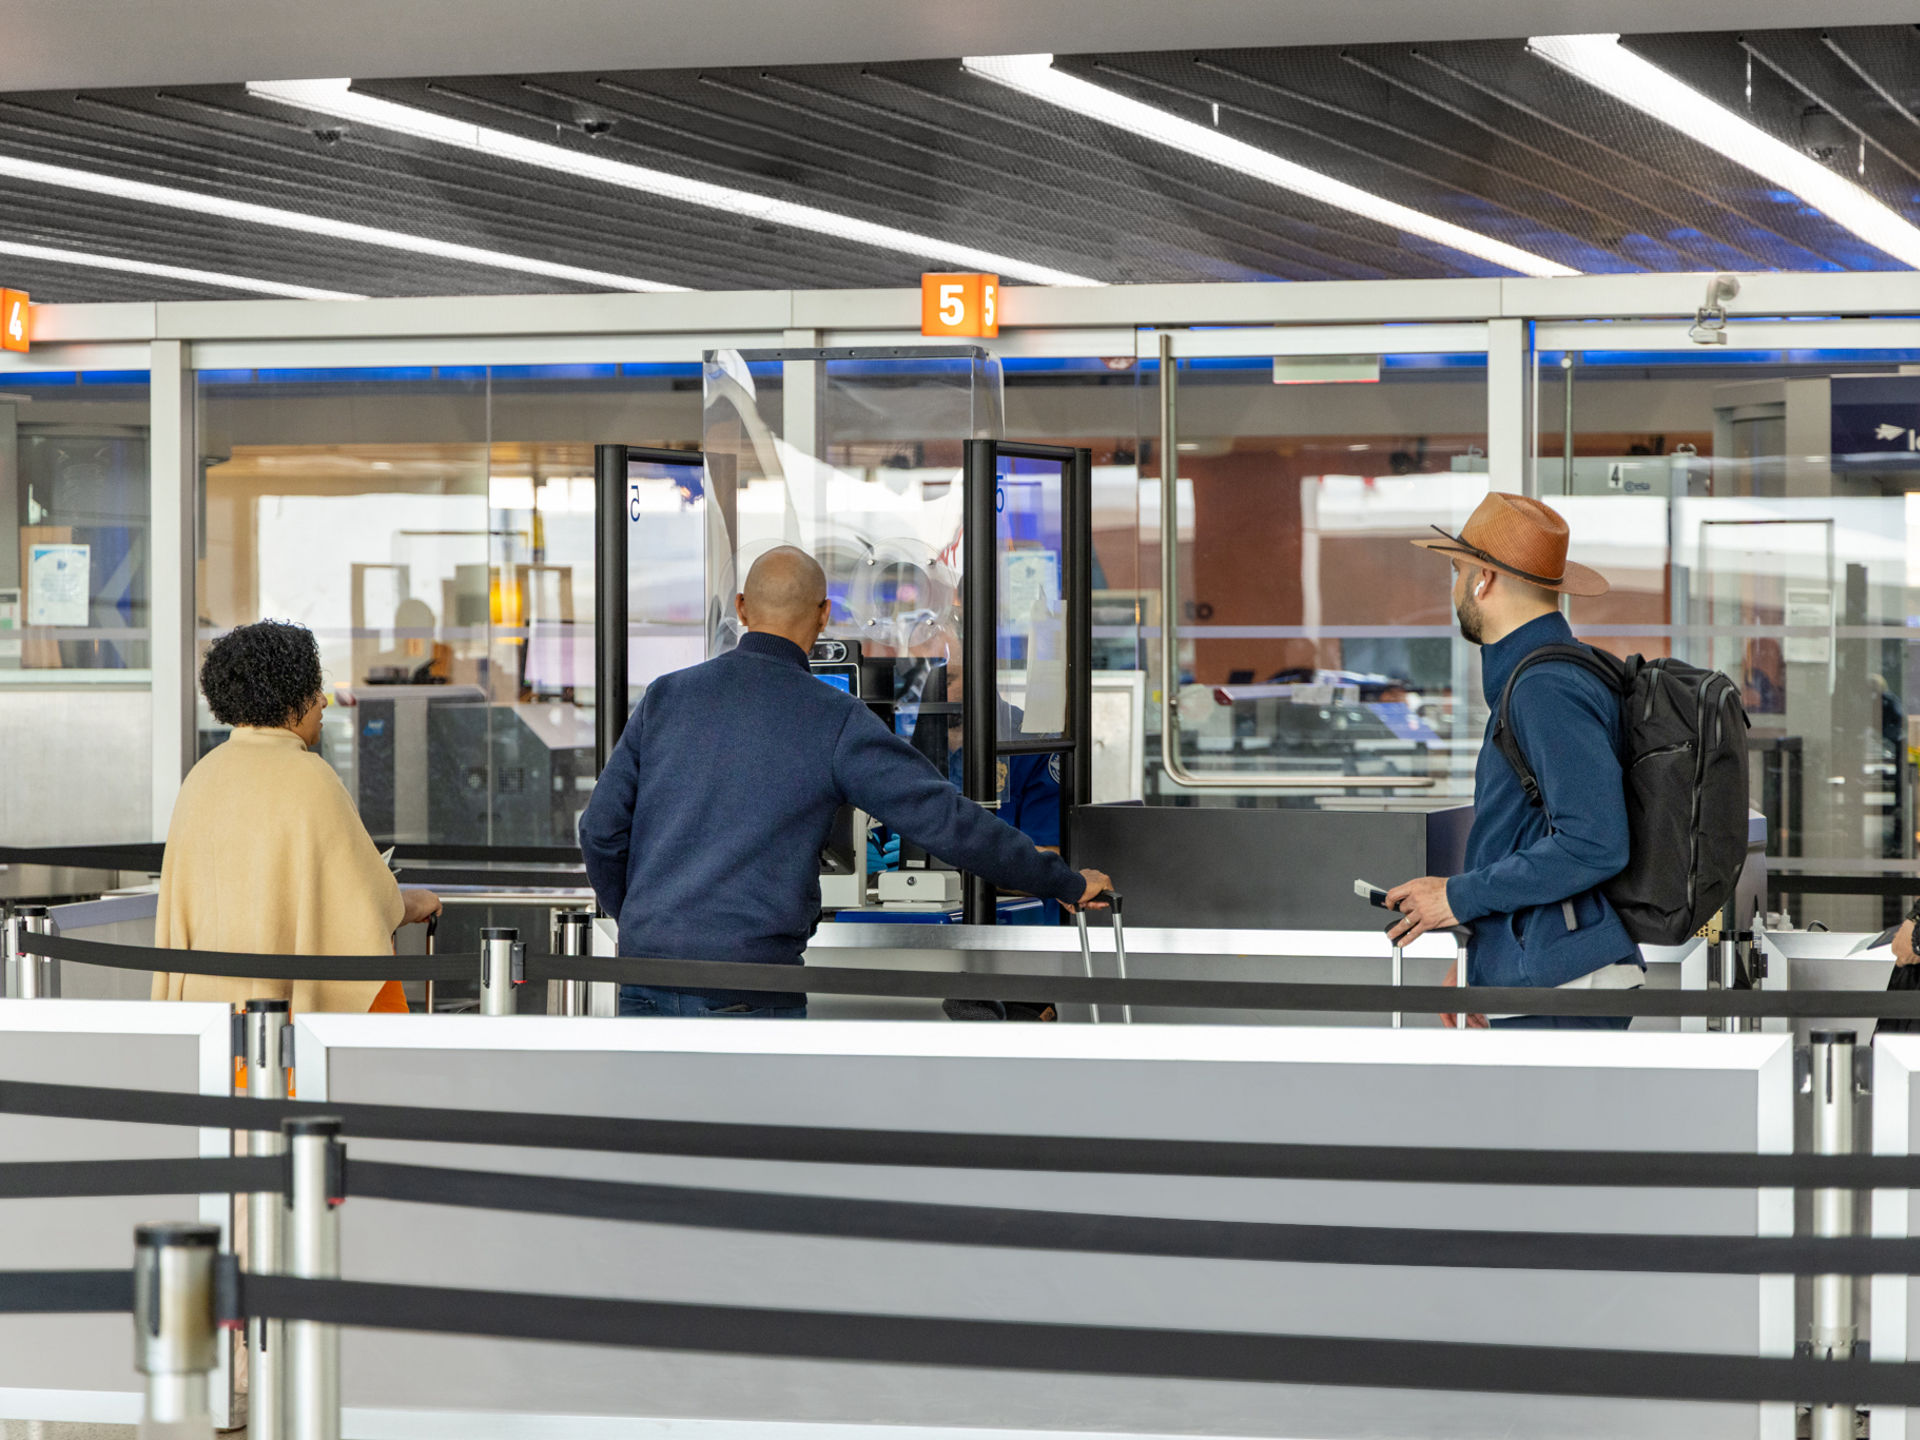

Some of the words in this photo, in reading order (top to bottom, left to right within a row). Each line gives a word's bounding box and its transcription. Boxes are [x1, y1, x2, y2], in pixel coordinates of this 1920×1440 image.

[9, 301, 23, 341] 4
[940, 284, 965, 326] 5
[985, 285, 995, 327] 5
[1611, 465, 1620, 487] 4
